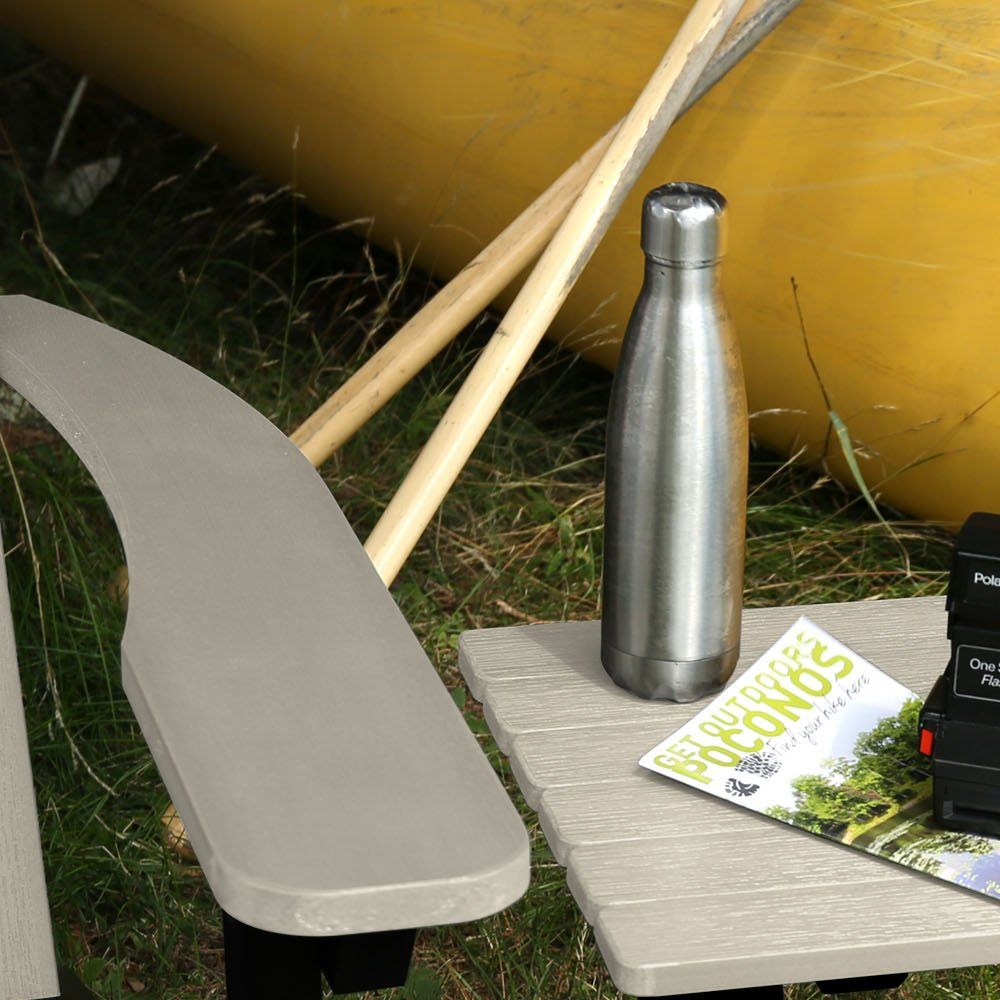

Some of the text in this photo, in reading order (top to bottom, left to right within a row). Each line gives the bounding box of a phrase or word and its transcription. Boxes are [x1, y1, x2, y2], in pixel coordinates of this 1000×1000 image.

[969, 657, 996, 673] One
[672, 638, 854, 785] POCONOS
[653, 734, 698, 770] GET
